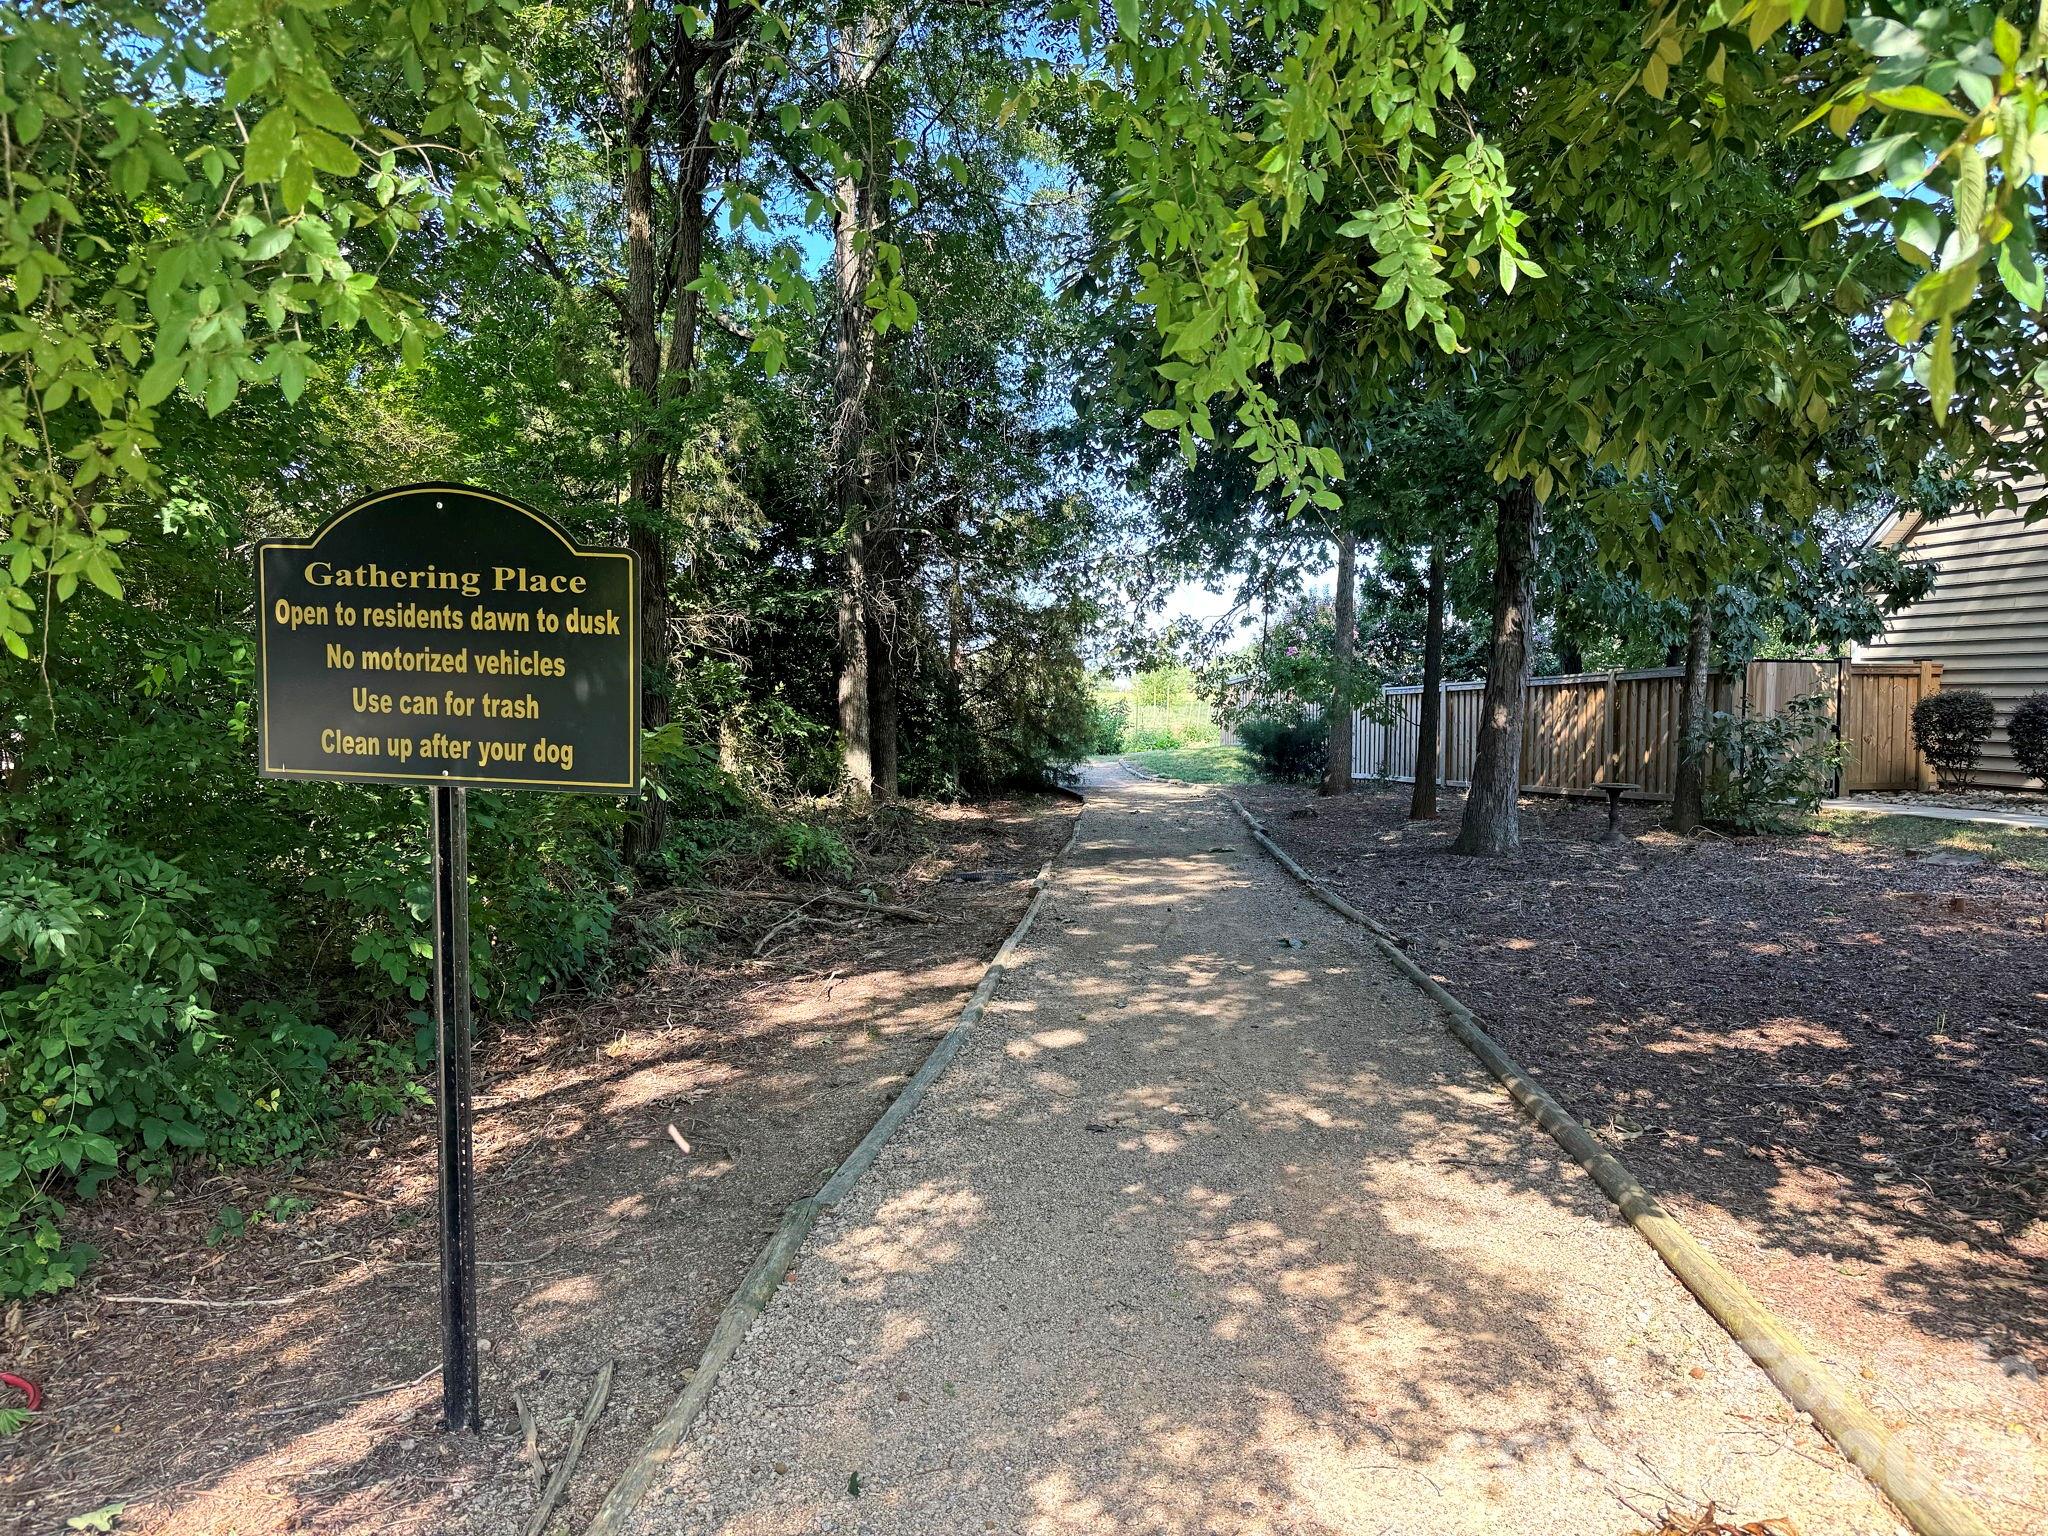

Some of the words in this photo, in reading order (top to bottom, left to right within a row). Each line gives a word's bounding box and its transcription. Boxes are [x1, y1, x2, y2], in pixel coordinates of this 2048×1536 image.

[304, 562, 481, 597] Gathering
[492, 566, 587, 594] Place
[274, 598, 329, 631] Open
[335, 603, 356, 627] to
[363, 602, 464, 630] residents
[470, 605, 529, 632] dawn
[537, 609, 559, 633] to
[566, 608, 621, 635] dusk
[326, 643, 355, 669] No
[361, 647, 468, 674] motorized
[474, 649, 566, 677] vehicles
[352, 687, 393, 714] Use
[400, 696, 438, 716] can
[444, 690, 475, 717] for
[482, 693, 540, 720] trash
[321, 728, 380, 756] Clean
[387, 738, 413, 763] up
[419, 733, 471, 759] after
[478, 740, 526, 767] your
[533, 738, 574, 771] dog
